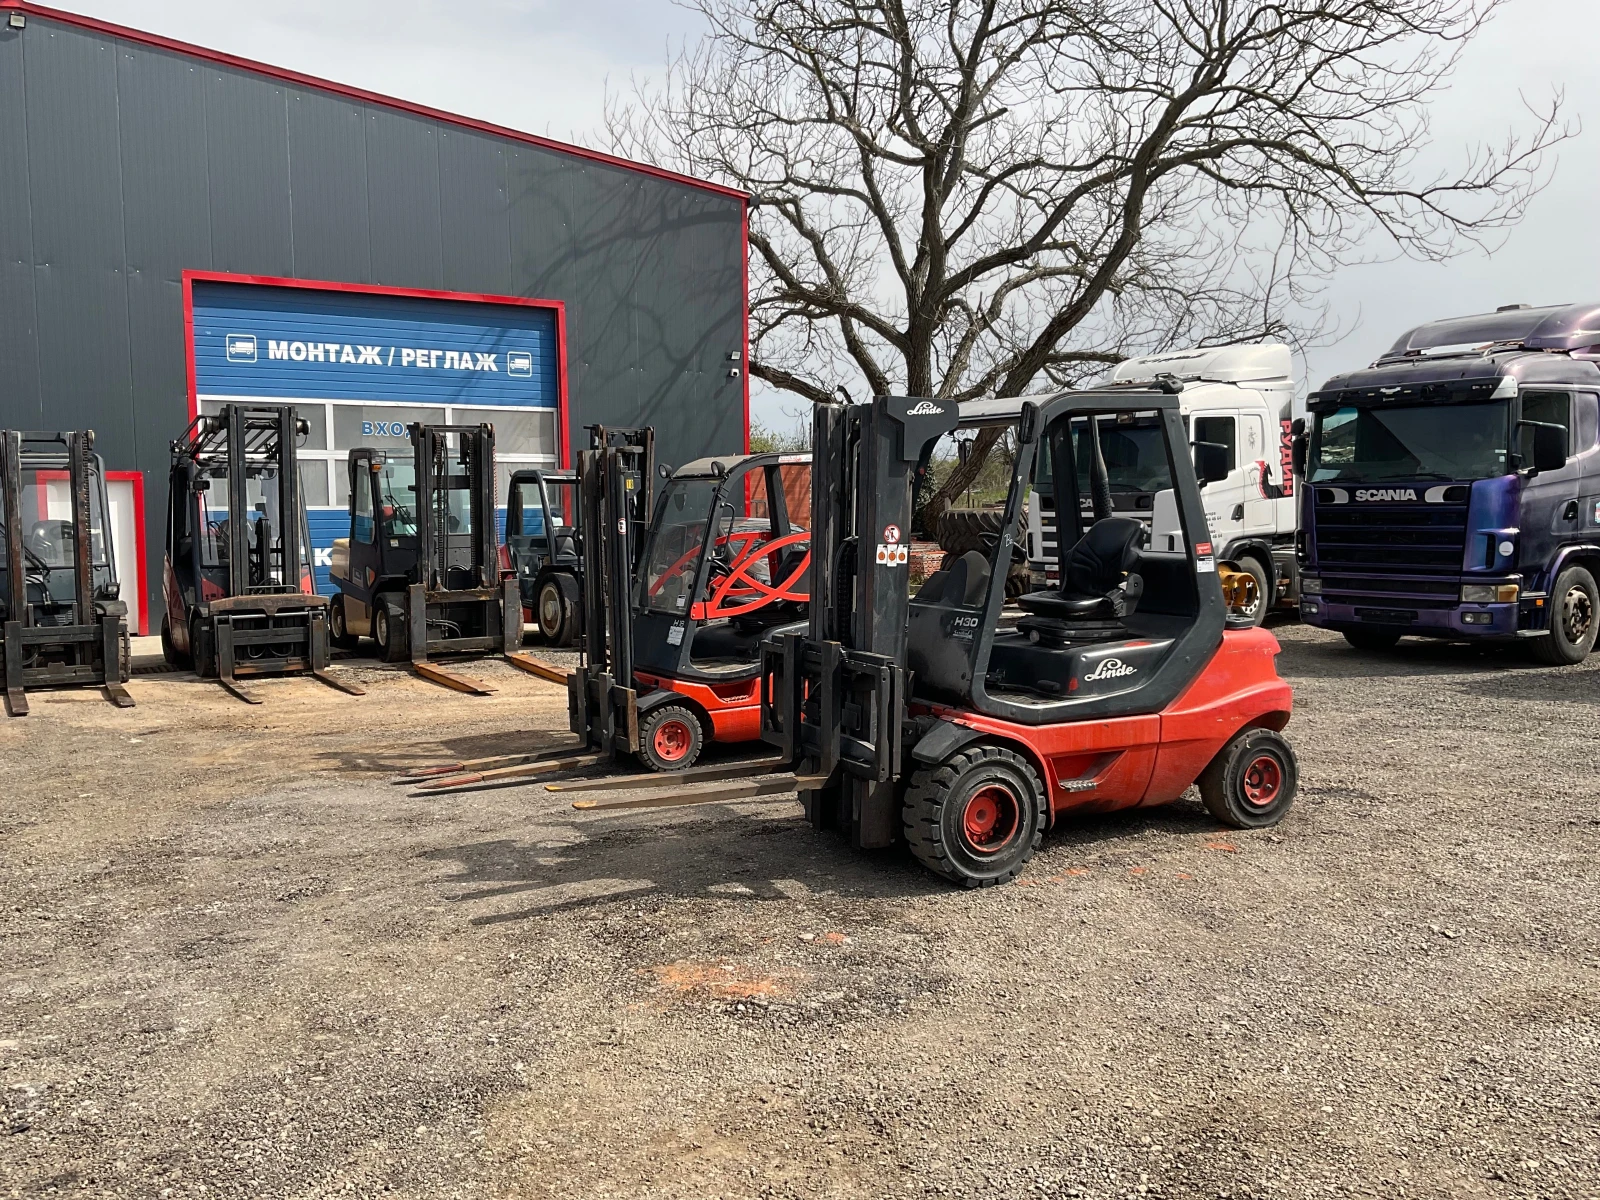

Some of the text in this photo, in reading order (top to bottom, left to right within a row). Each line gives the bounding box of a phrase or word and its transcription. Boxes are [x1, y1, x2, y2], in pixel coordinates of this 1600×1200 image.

[268, 340, 383, 365] МОНТАЖ
[401, 348, 498, 371] РЕГЛАЖ
[907, 401, 945, 415] Linde
[1355, 489, 1418, 502] SCANIA
[954, 616, 979, 628] H30
[1084, 658, 1138, 681] Linde
